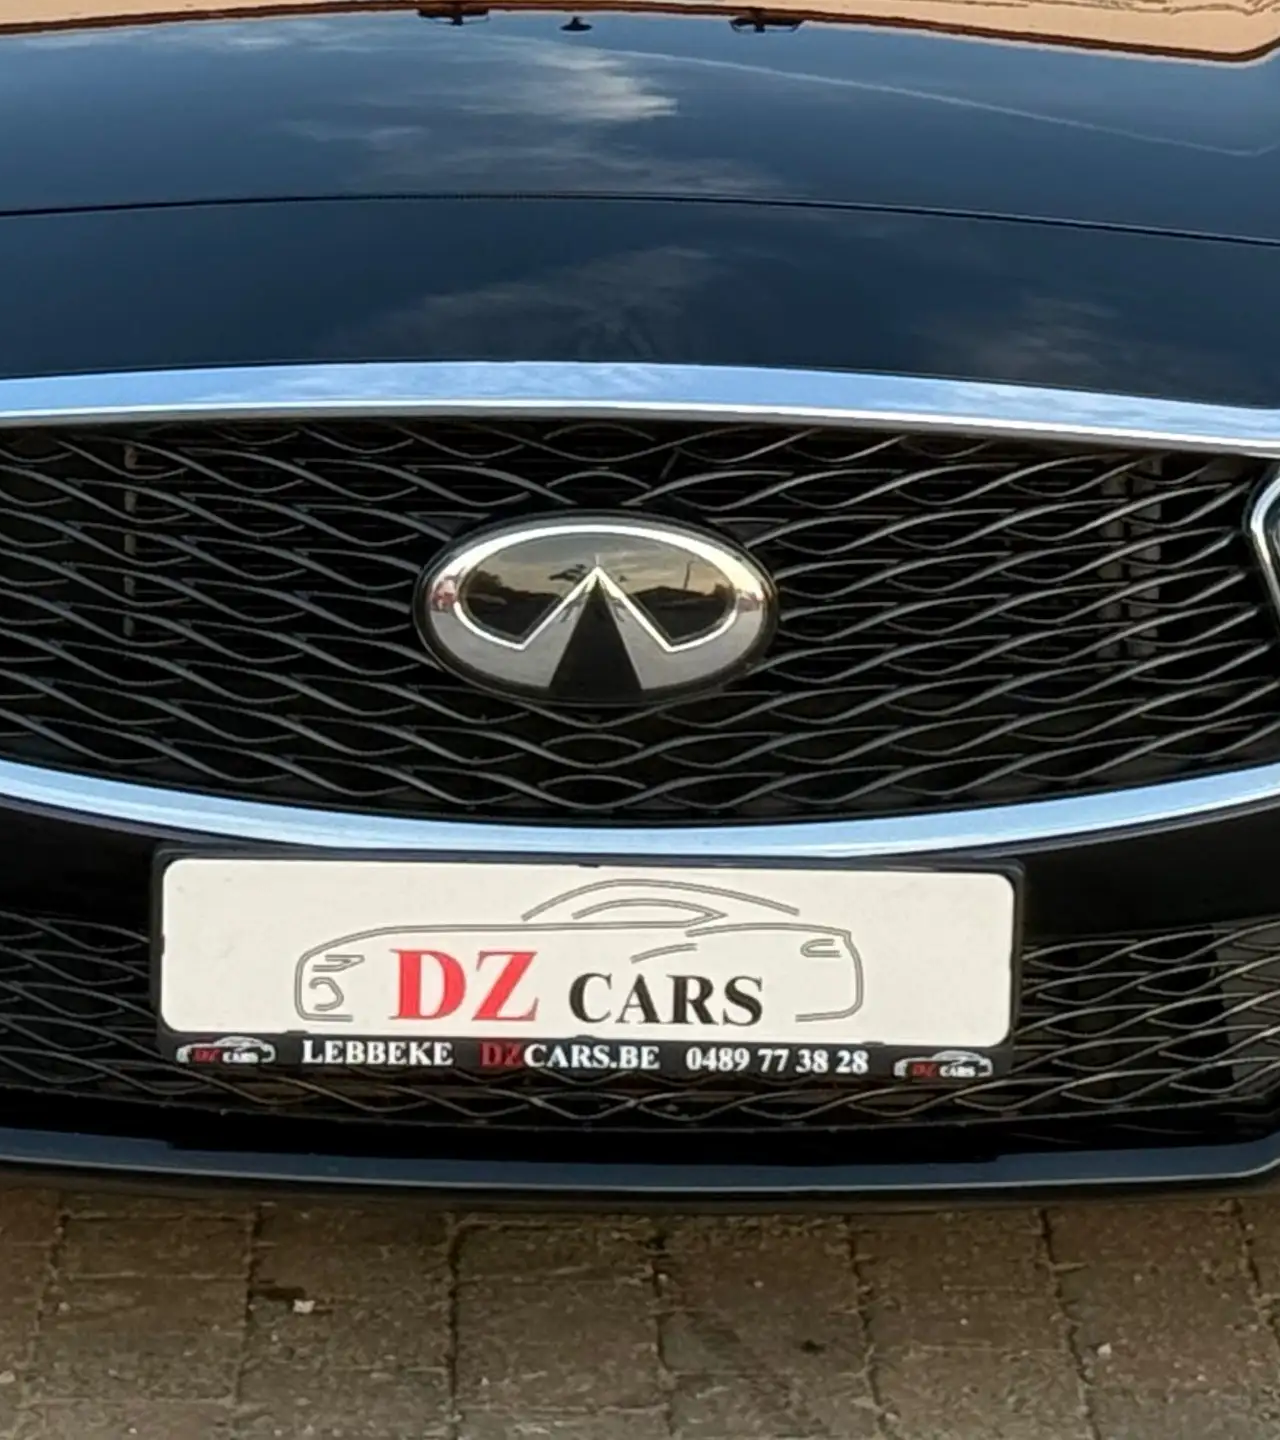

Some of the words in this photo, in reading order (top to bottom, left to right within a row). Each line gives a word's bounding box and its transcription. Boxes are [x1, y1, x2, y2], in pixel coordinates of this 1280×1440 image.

[388, 948, 540, 1022] DZ
[568, 971, 765, 1027] CARS
[221, 1051, 259, 1064] CARS
[302, 1038, 454, 1067] LEBBEKE
[478, 1041, 661, 1071] DZCARS.BE
[685, 1046, 750, 1073] 0489
[757, 1047, 790, 1073] 77
[795, 1048, 829, 1075] 38
[835, 1049, 870, 1076] 28
[938, 1062, 977, 1078] CARS
